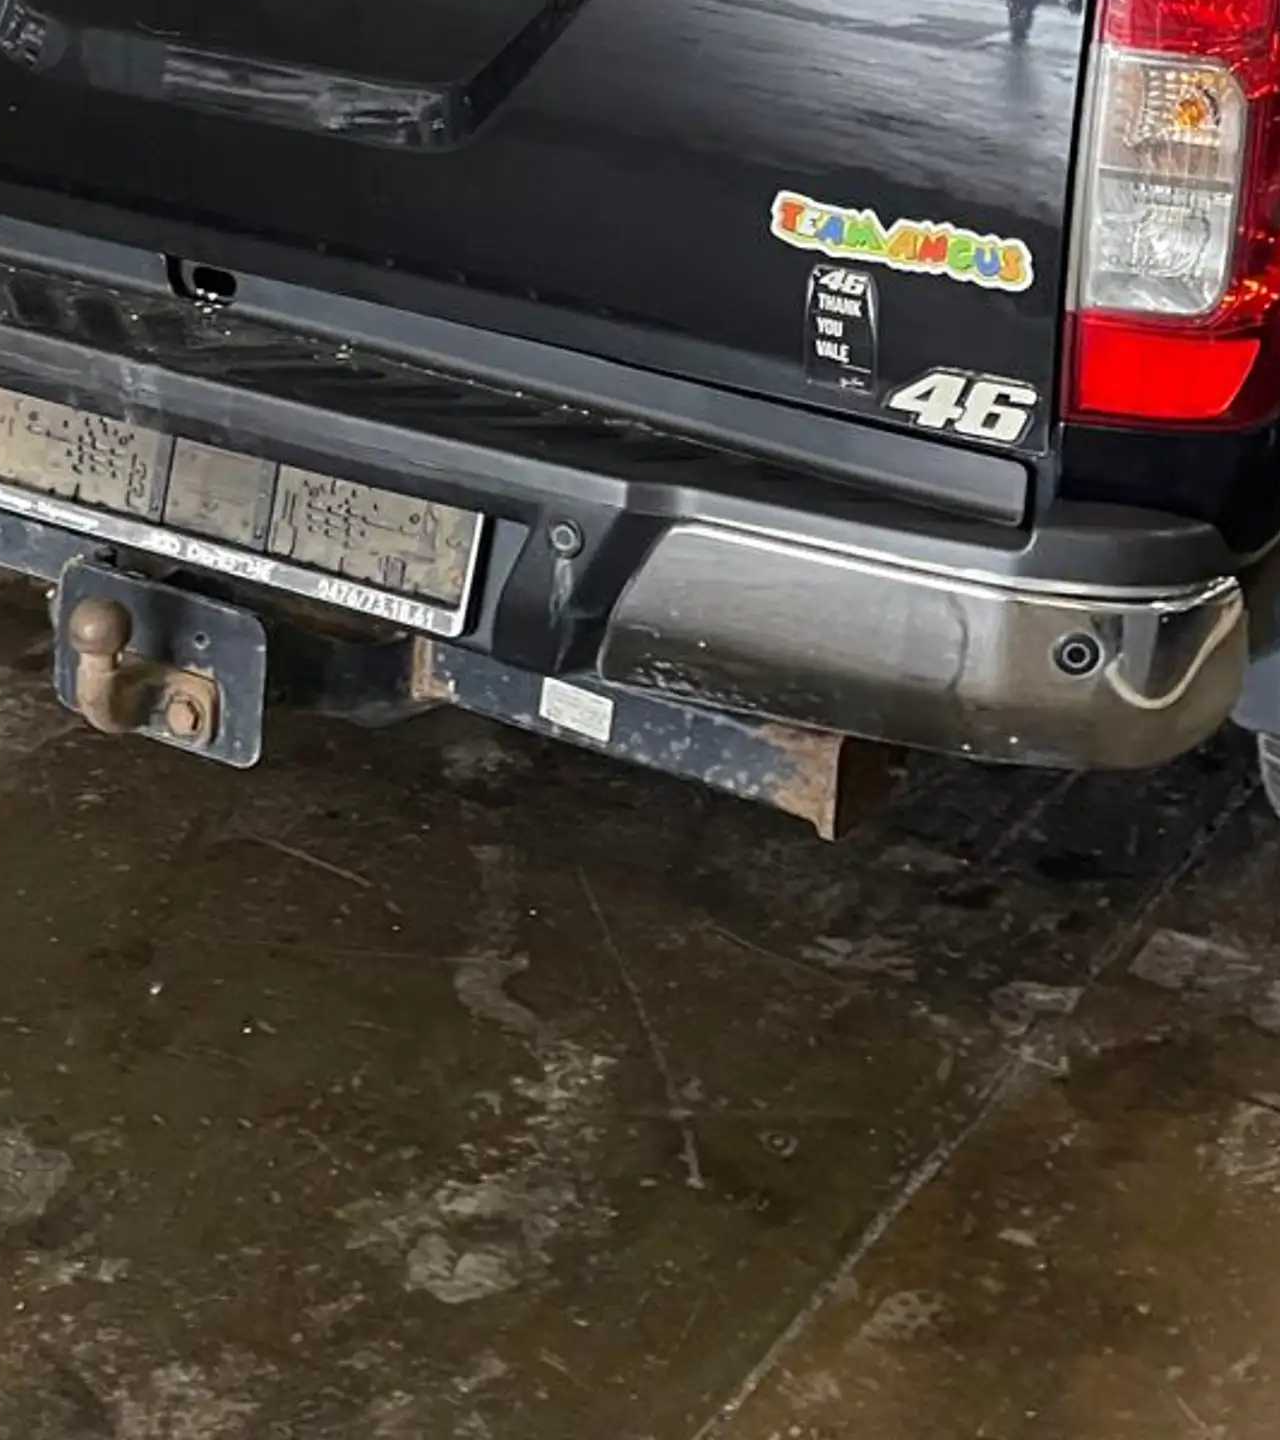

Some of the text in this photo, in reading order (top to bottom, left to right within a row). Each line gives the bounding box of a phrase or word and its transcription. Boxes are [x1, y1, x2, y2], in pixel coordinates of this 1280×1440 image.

[778, 200, 1026, 282] TEAM ANGUS
[818, 269, 869, 296] 46
[817, 292, 863, 318] THANK
[816, 317, 844, 337] YOU
[815, 340, 851, 364] VALE
[888, 373, 1037, 440] 46
